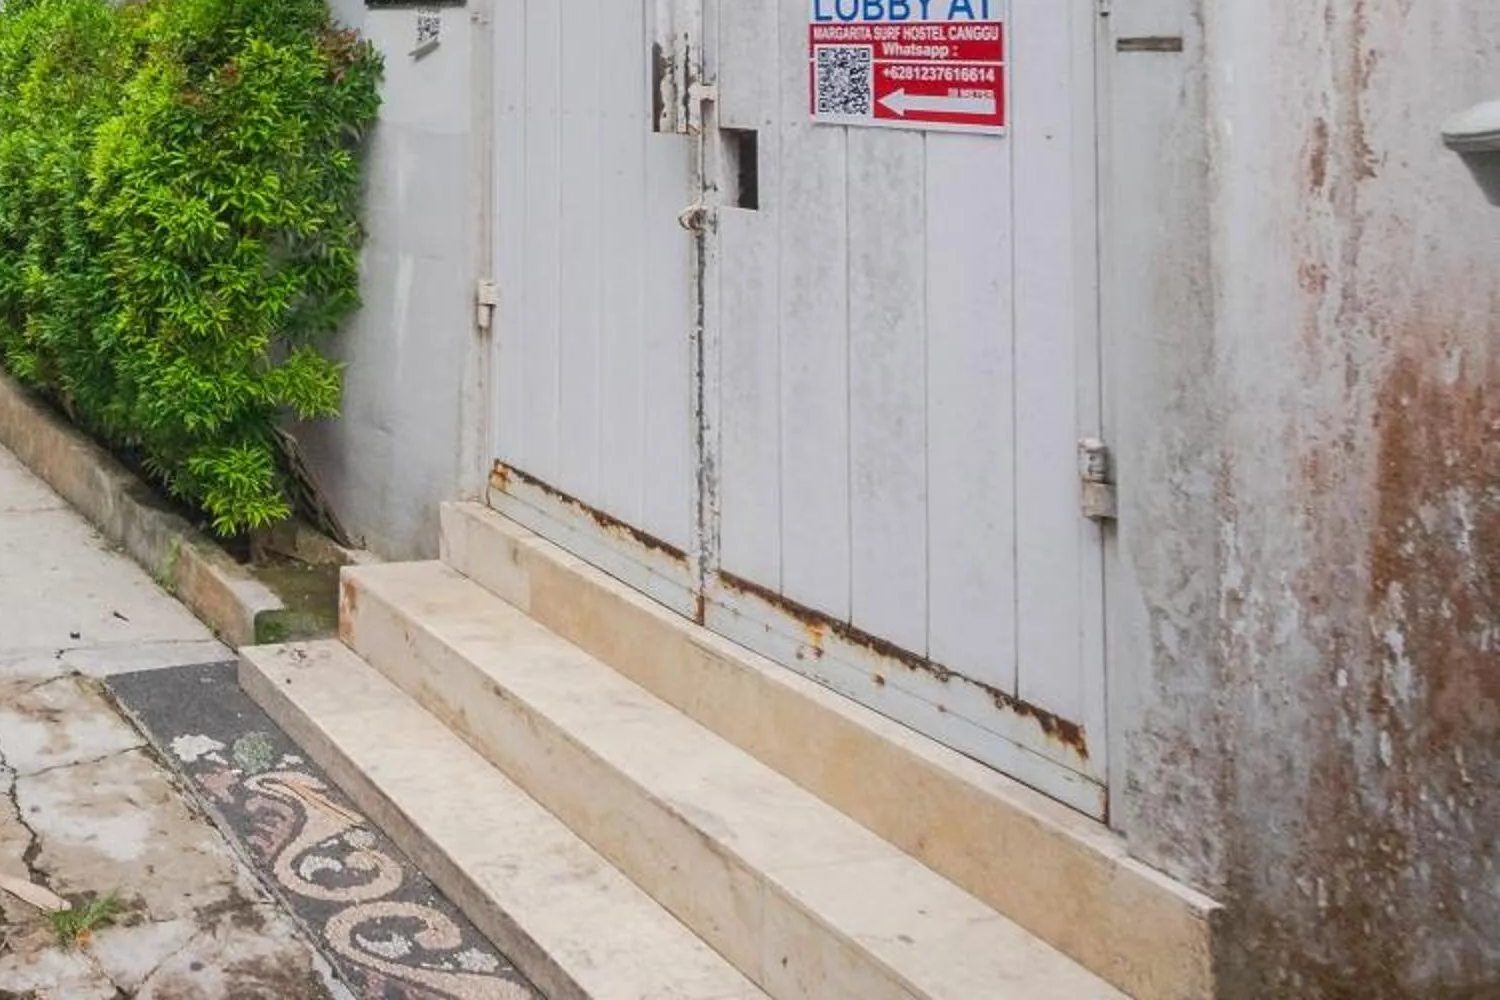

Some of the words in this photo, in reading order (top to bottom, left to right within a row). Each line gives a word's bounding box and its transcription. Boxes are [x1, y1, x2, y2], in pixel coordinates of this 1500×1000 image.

[813, 25, 872, 40] MARGARITA
[873, 25, 900, 41] SURF
[903, 25, 947, 41] HOSTEL
[948, 25, 999, 41] CANGGU
[882, 41, 949, 60] Whatsapp
